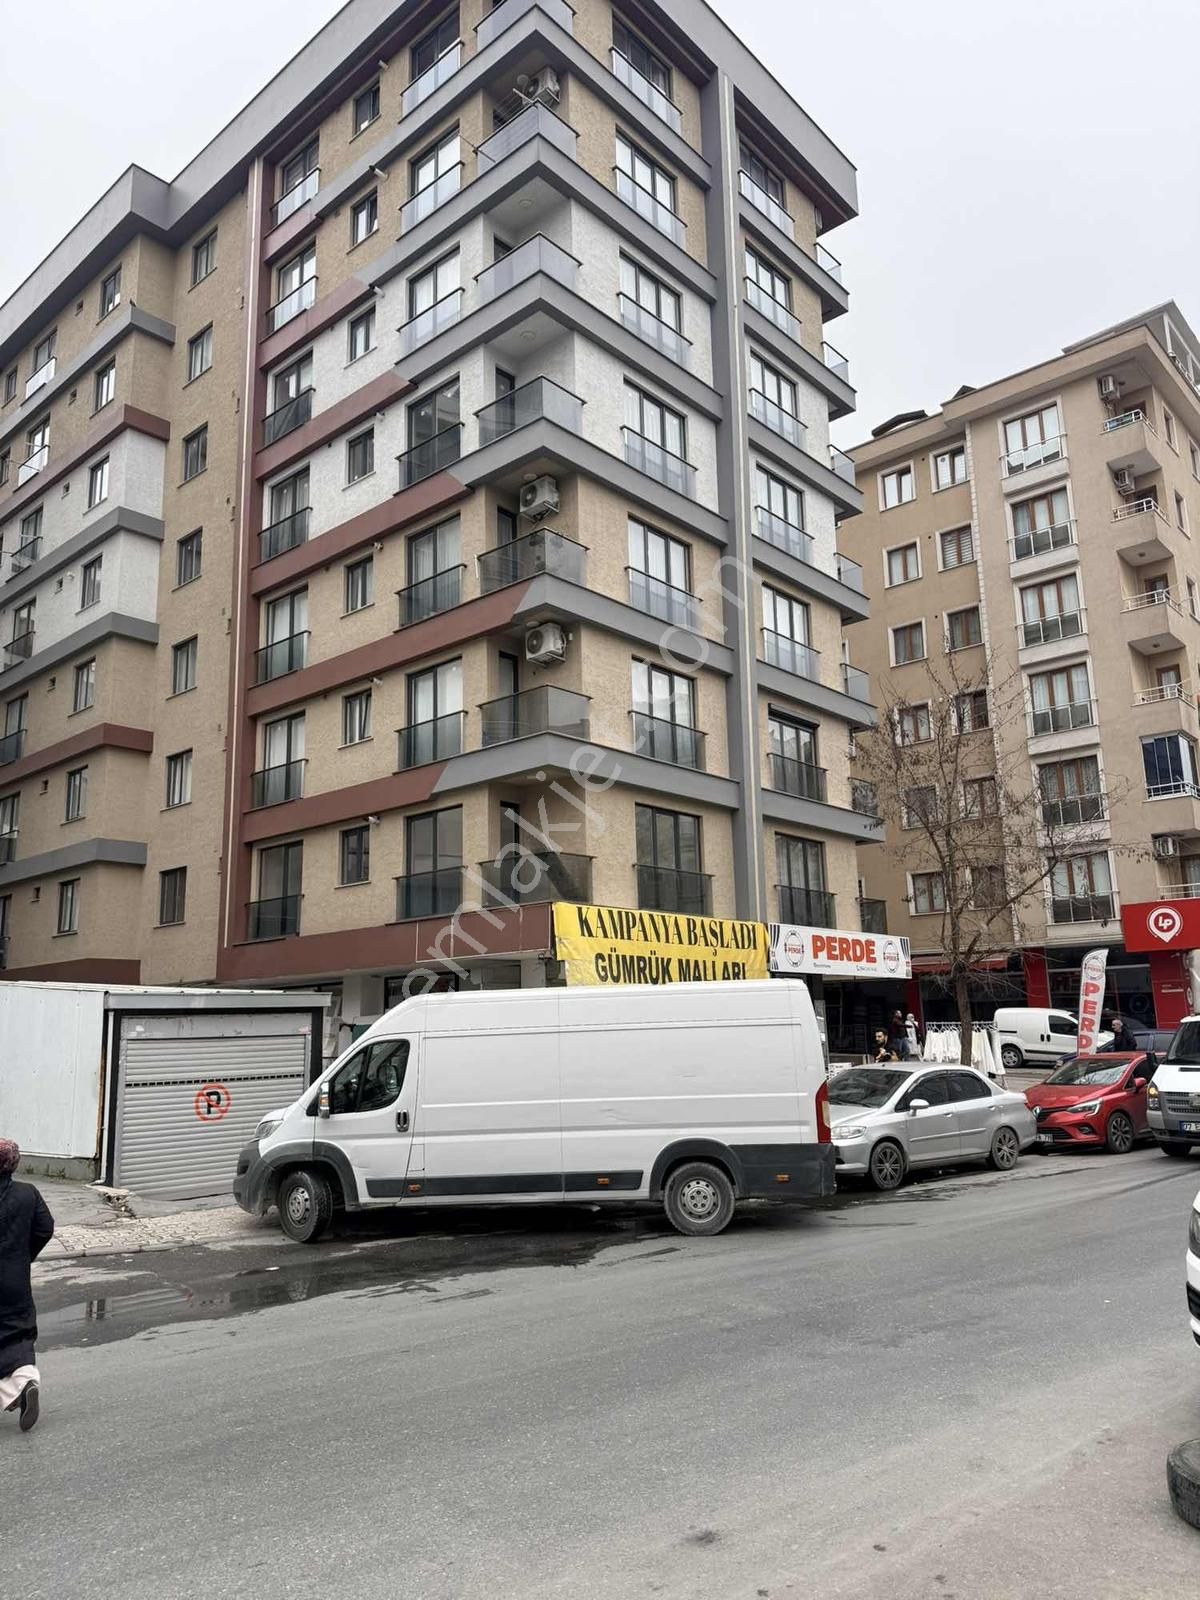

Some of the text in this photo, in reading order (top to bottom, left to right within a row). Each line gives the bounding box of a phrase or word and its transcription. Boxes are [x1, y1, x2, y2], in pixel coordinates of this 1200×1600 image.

[576, 906, 758, 957] KAMPANYA BAŞLADI
[811, 934, 877, 963] PERDE
[594, 947, 747, 985] GÜMRÜK MALLARI
[1078, 982, 1101, 1056] PERD
[206, 1090, 221, 1115] P
